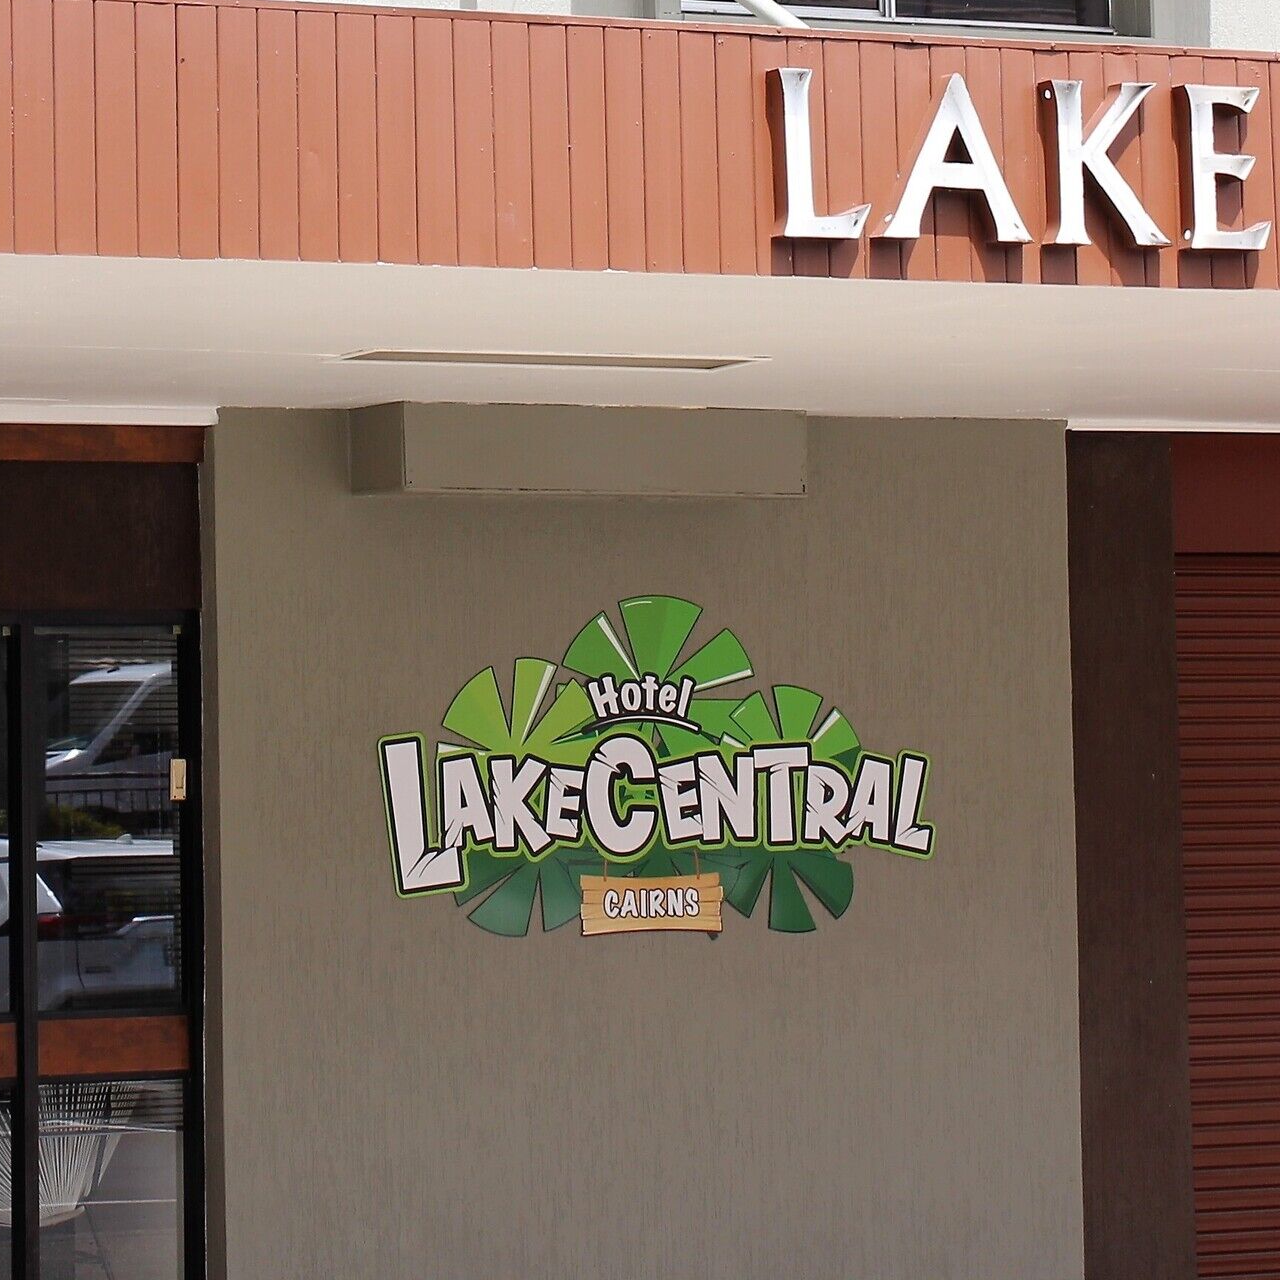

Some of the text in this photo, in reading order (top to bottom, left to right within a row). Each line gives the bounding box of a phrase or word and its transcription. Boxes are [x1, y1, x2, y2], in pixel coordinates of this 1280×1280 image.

[770, 66, 1272, 251] LAKE
[587, 673, 695, 720] Hotel
[603, 888, 700, 920] CAIRNS
